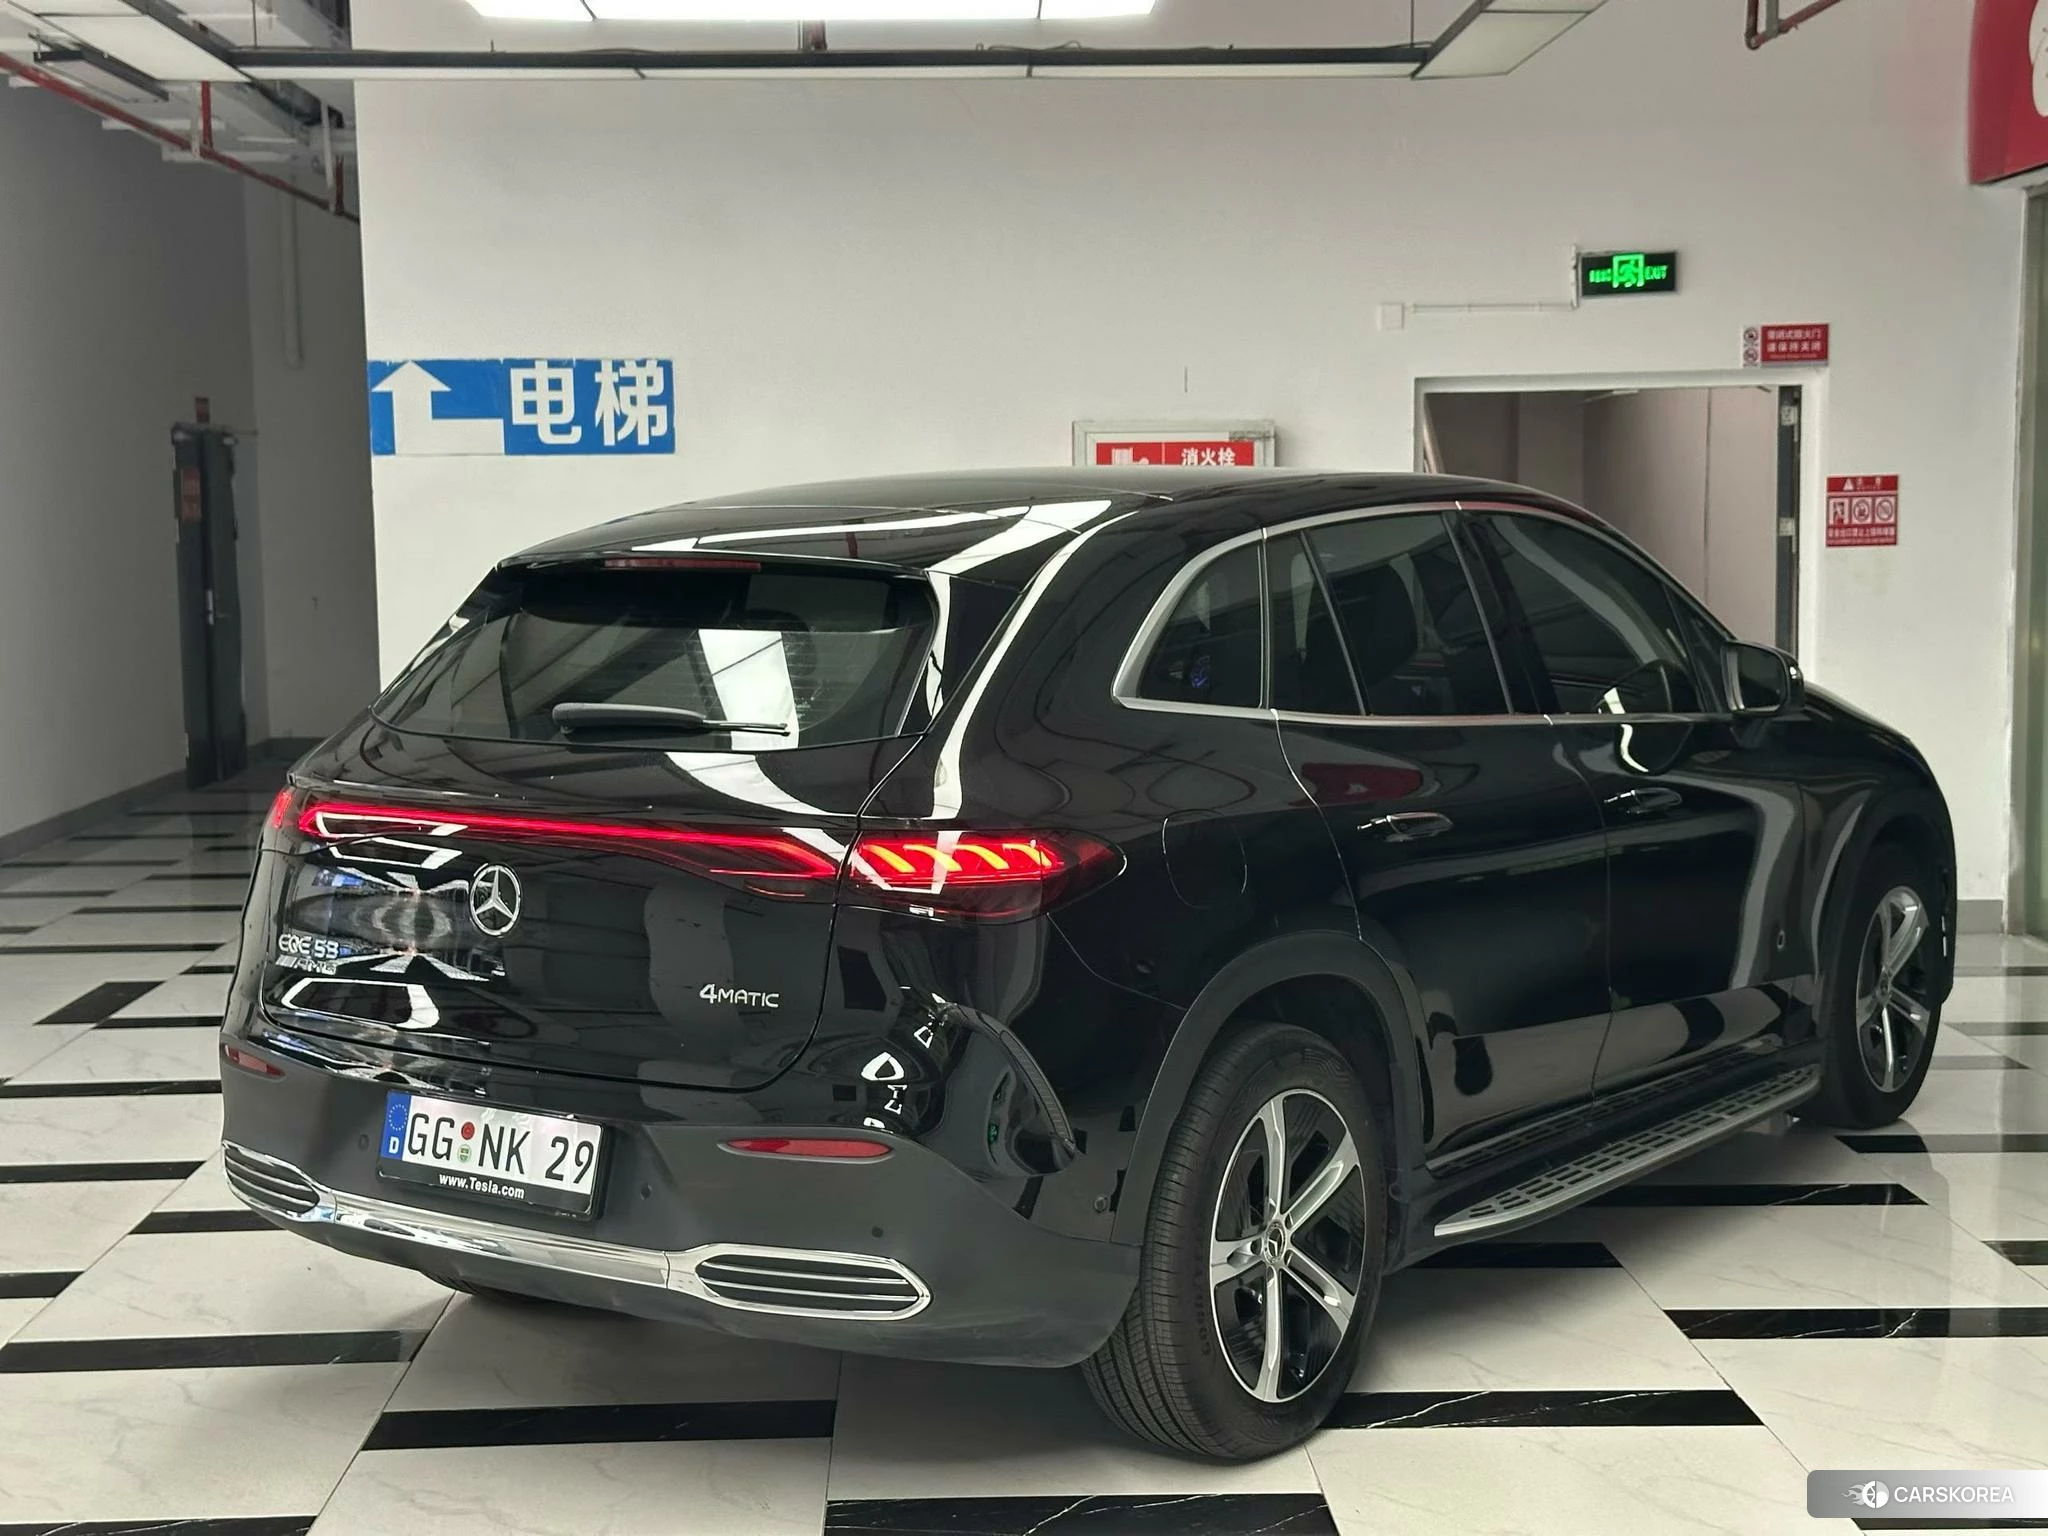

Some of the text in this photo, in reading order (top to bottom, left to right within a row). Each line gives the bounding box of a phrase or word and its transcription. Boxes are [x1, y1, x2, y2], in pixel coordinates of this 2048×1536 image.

[510, 360, 668, 446] 电梯
[1181, 447, 1236, 466] 消火栓
[279, 934, 312, 954] EQE
[699, 983, 780, 1008] 4MATIC
[388, 1136, 400, 1154] D
[407, 1112, 595, 1184] GG NK 29
[439, 1173, 525, 1200] www.Tesla.com
